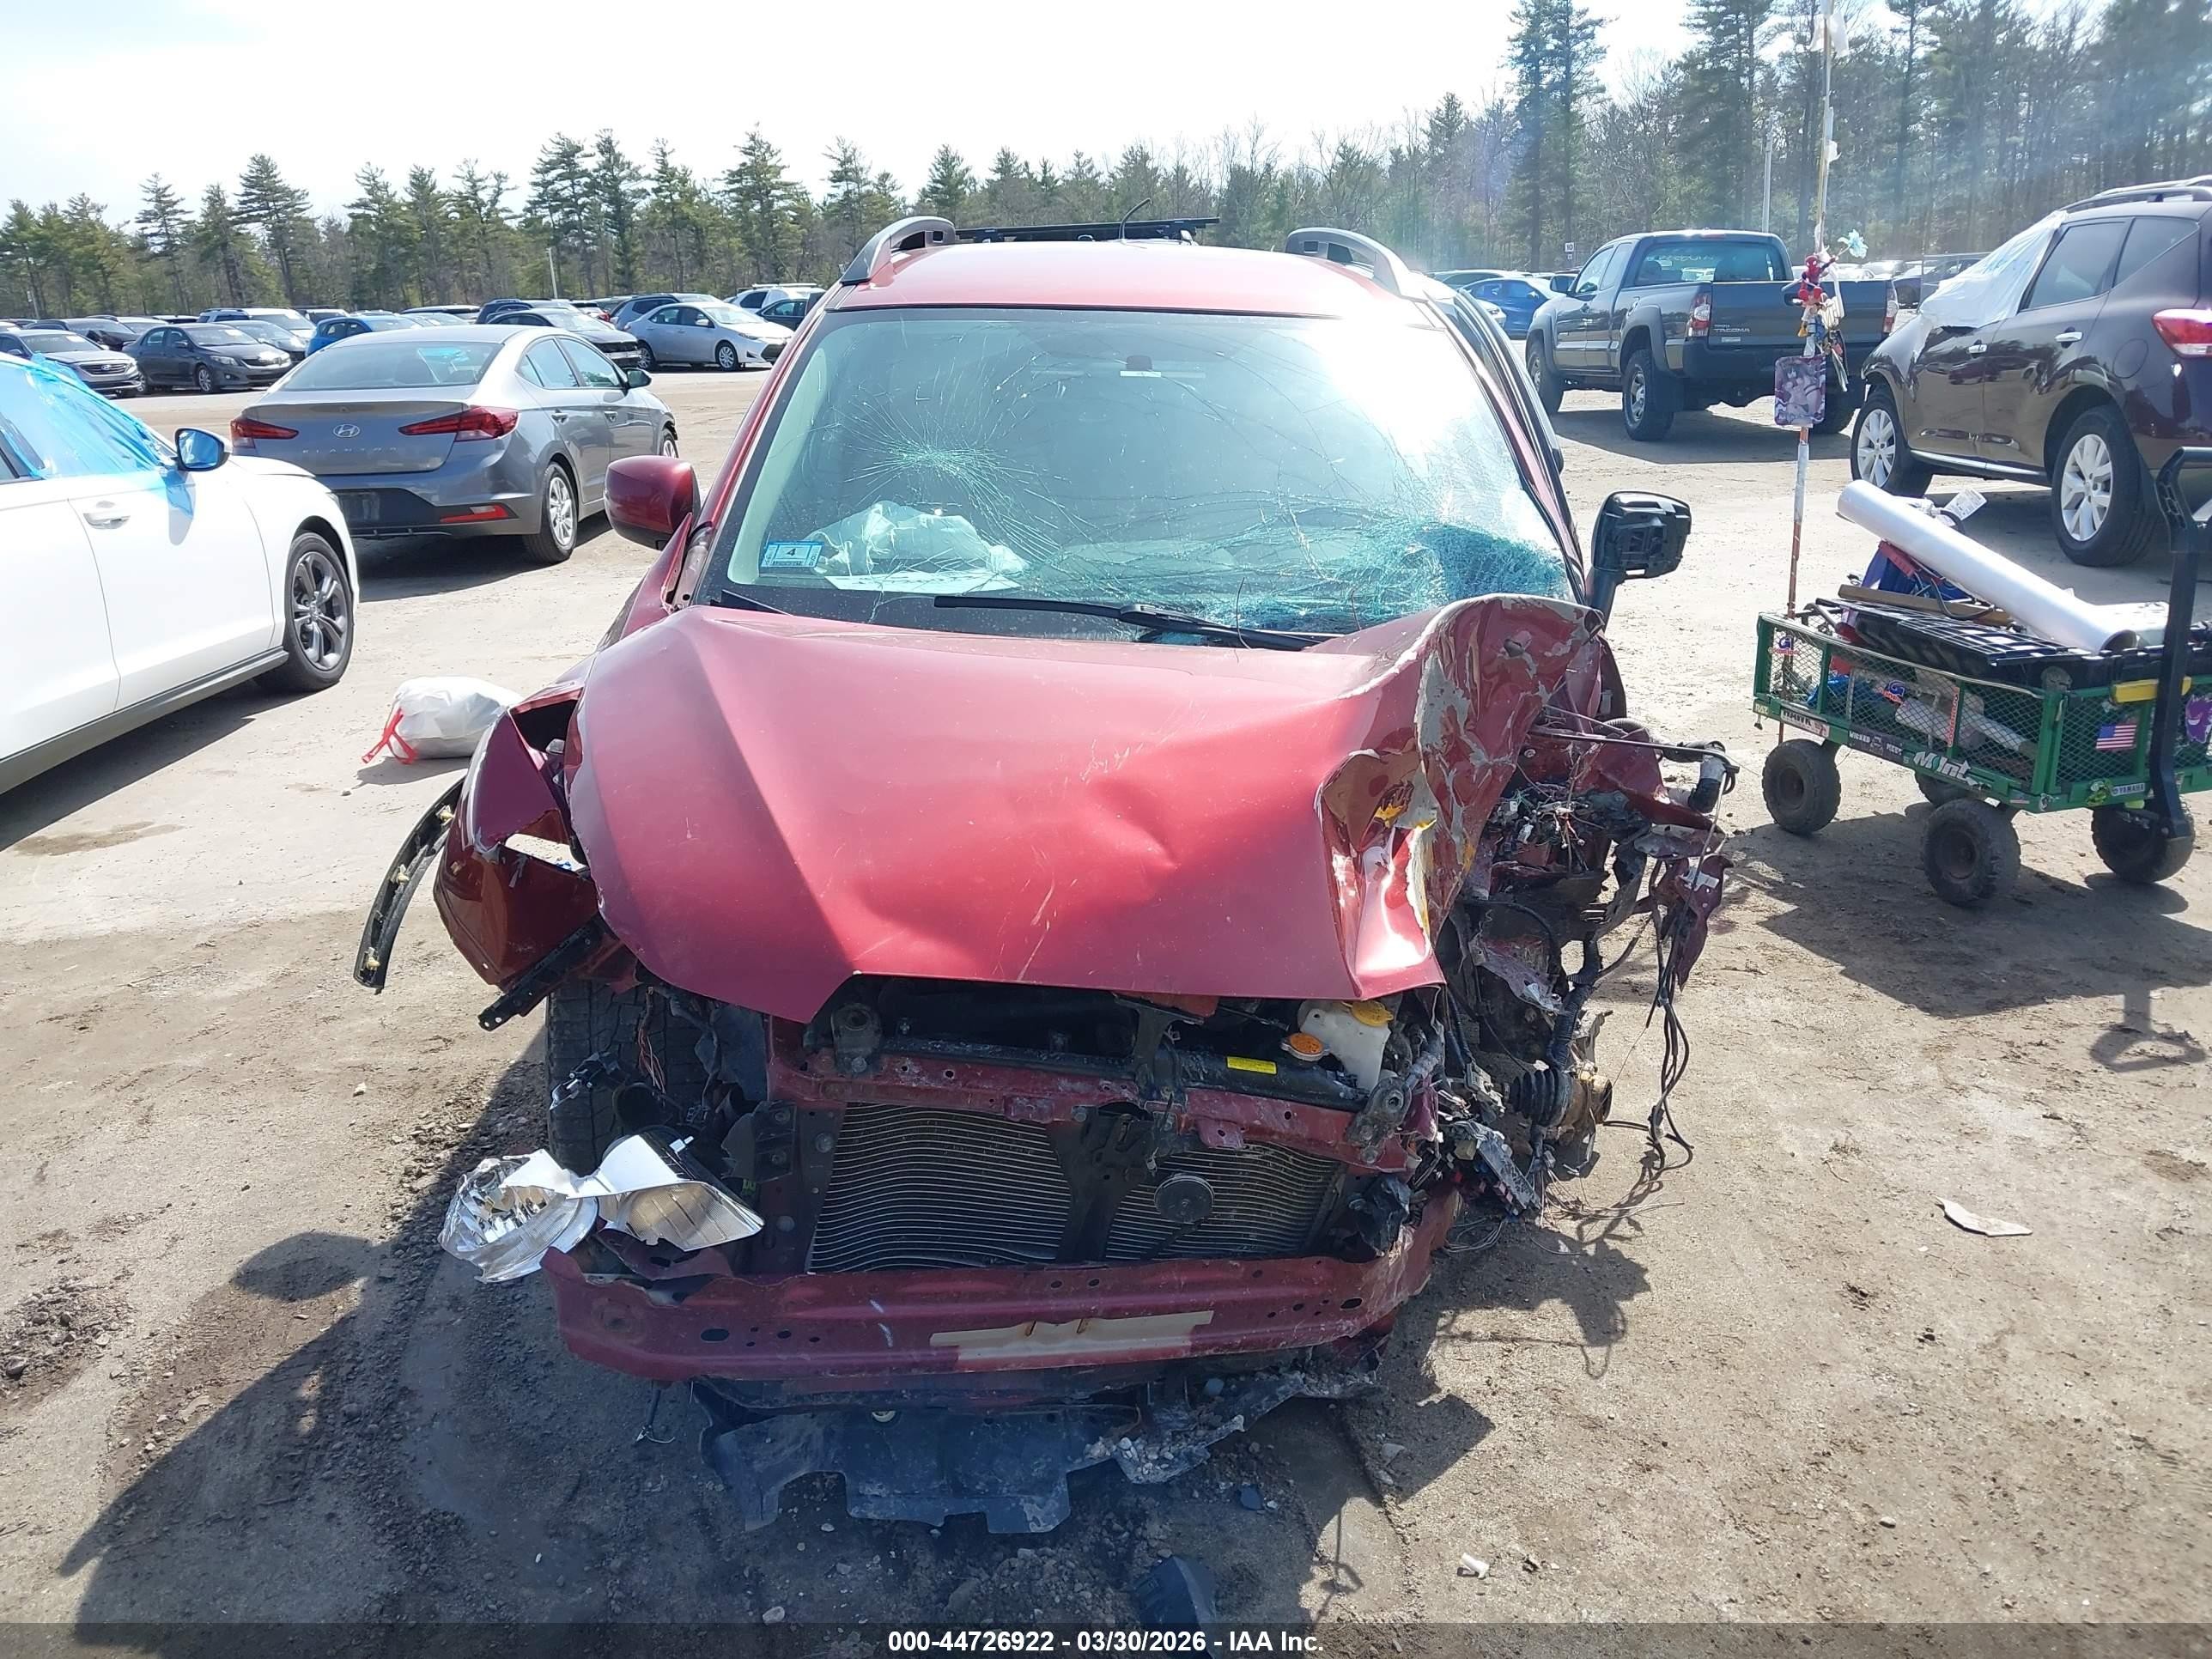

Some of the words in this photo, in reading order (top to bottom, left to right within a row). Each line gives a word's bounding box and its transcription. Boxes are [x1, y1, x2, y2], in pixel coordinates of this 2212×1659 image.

[786, 548, 797, 556] 4
[1849, 730, 1871, 743] WICKED
[2118, 783, 2144, 794] YAMAHA
